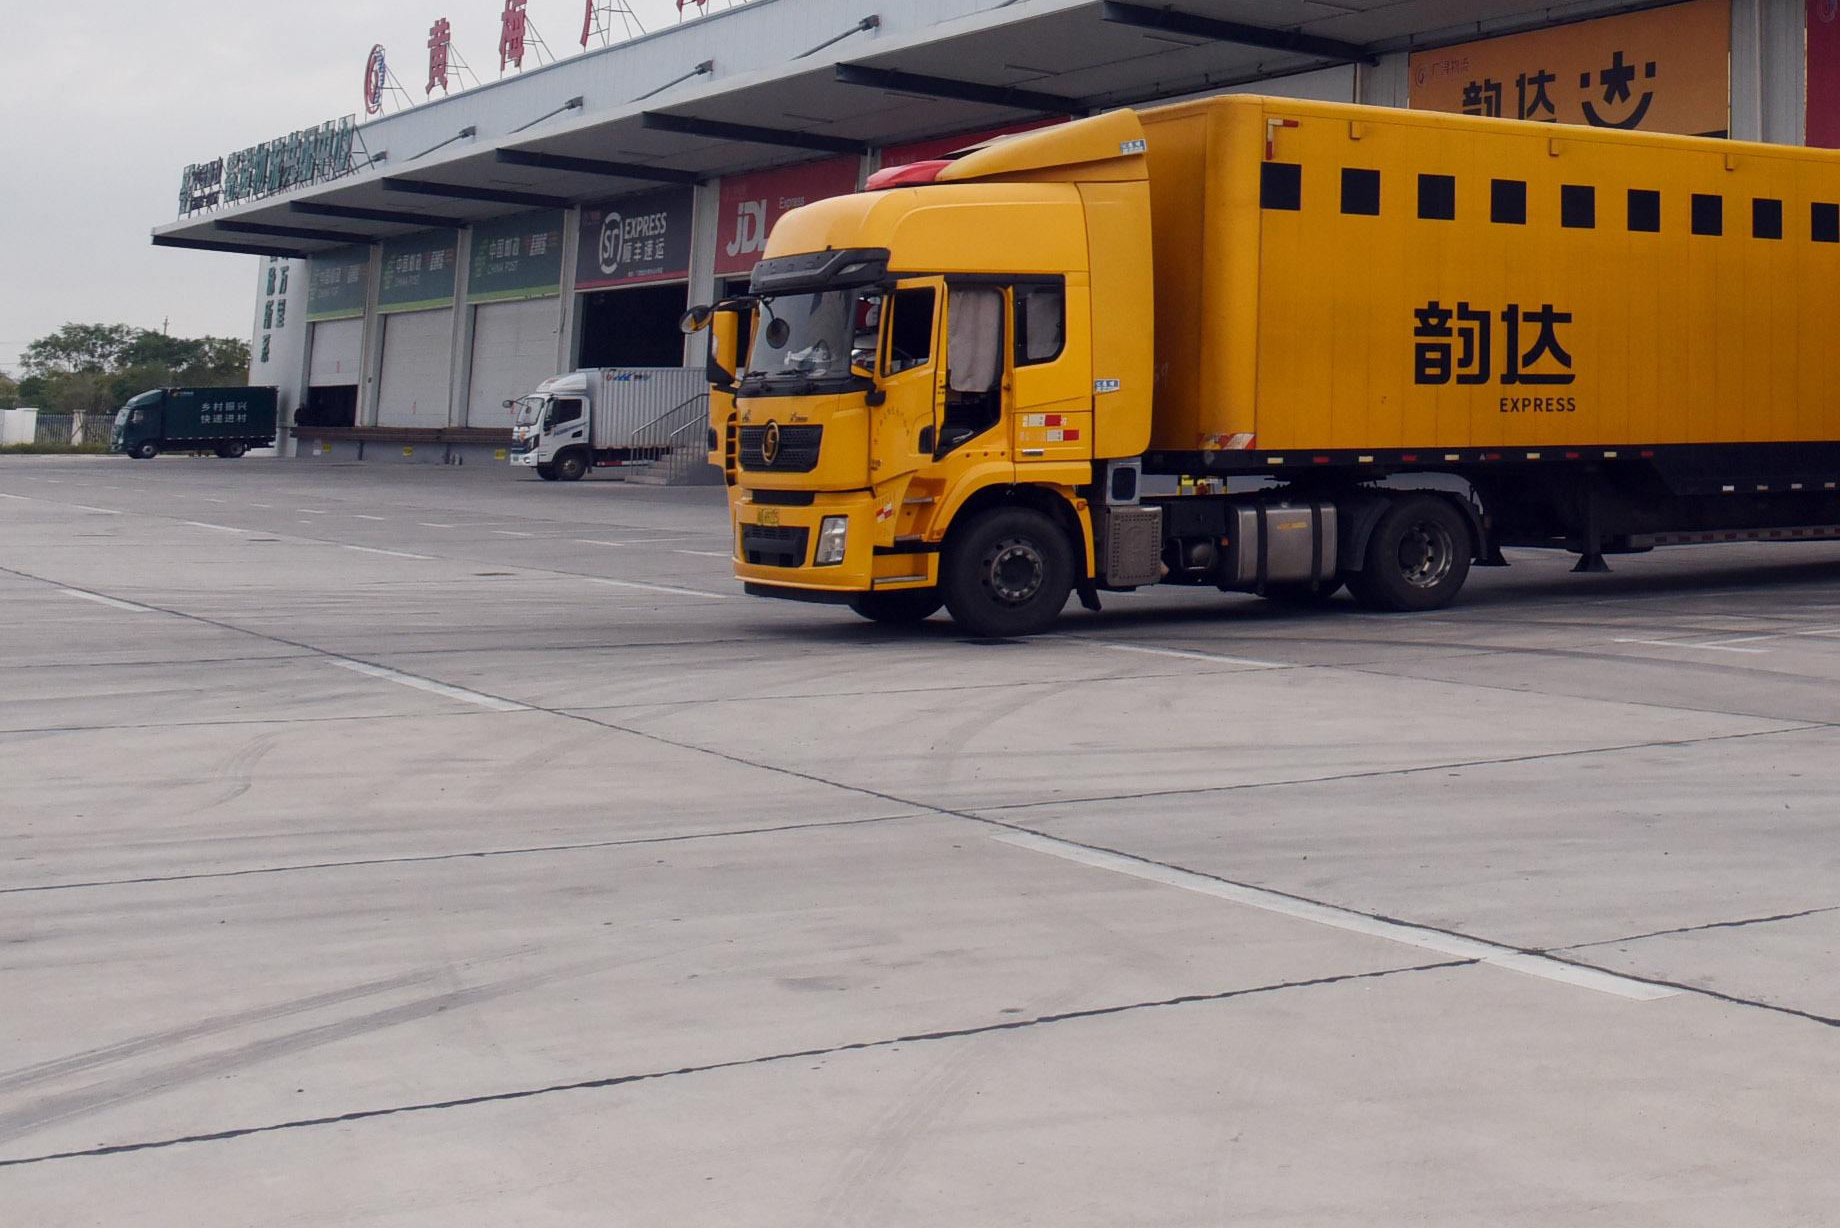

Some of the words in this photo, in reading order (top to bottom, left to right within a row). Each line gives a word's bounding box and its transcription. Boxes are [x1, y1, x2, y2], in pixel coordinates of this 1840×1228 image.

[1462, 69, 1557, 123] 韵达
[624, 212, 667, 239] EXPRESS
[1413, 300, 1576, 385] 韵达
[1499, 397, 1577, 413] EXPRESS
